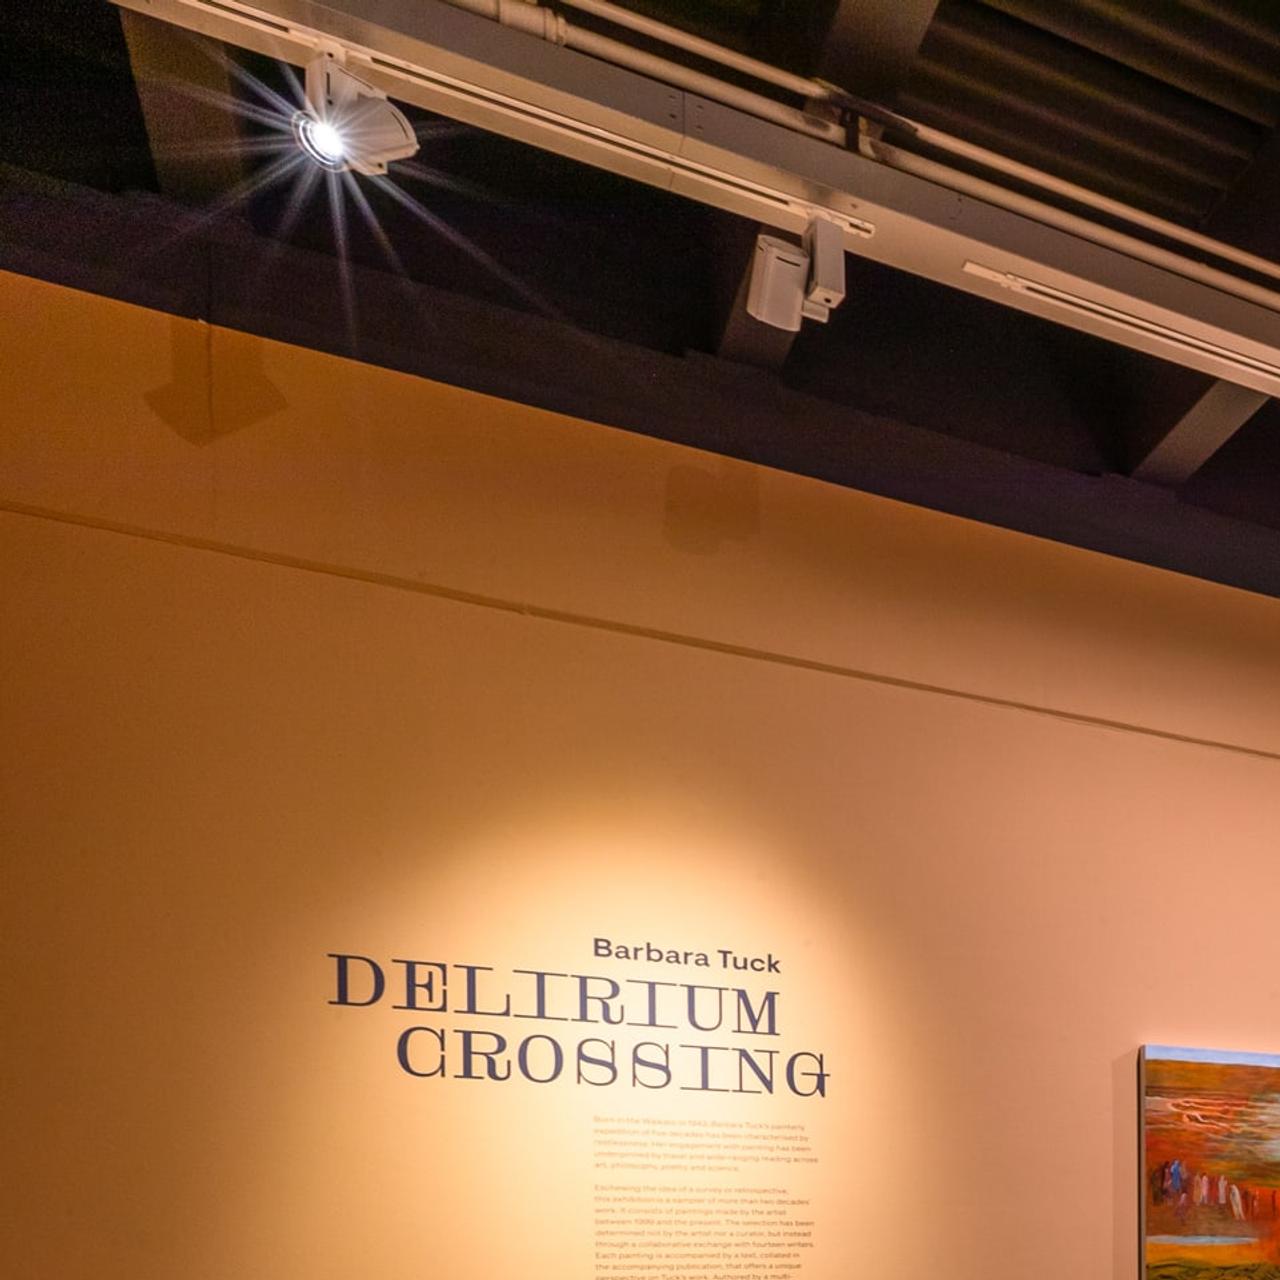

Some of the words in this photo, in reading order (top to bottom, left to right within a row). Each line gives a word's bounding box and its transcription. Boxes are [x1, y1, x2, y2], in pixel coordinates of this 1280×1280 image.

[593, 938, 709, 968] Barbara
[717, 950, 780, 974] Tuck
[328, 953, 780, 1036] DELIRIUM
[396, 1026, 830, 1098] CROSSING
